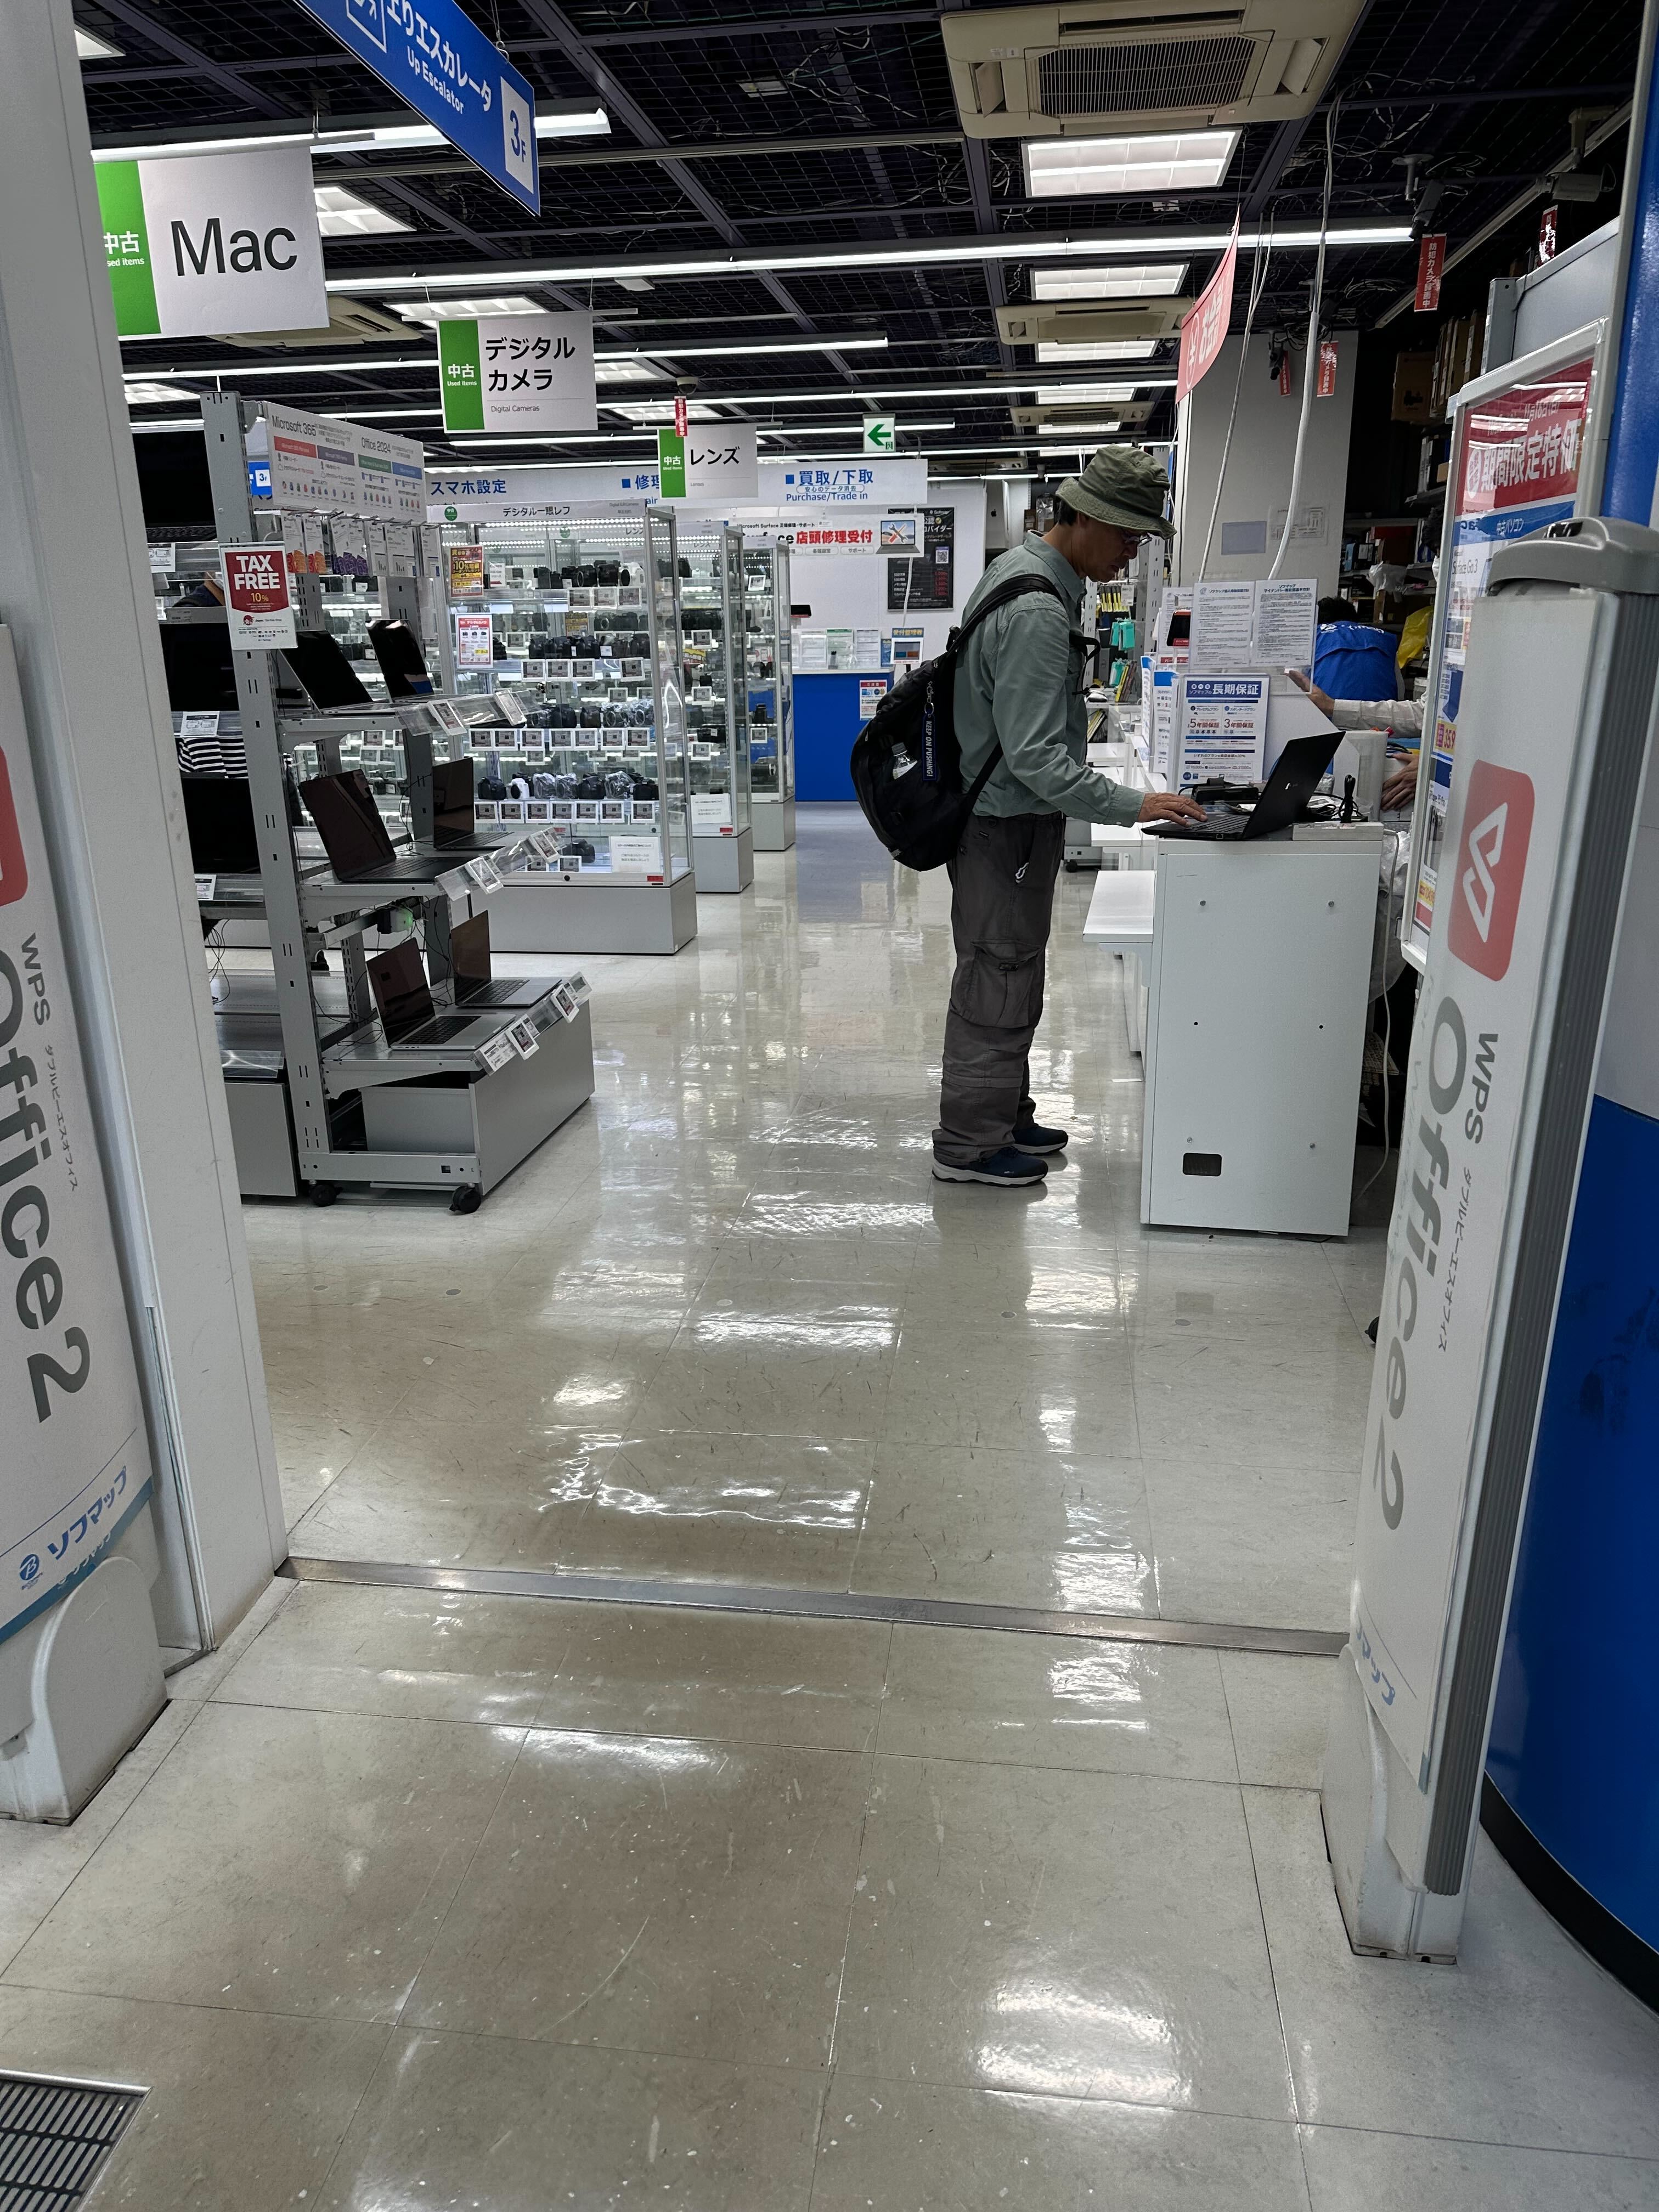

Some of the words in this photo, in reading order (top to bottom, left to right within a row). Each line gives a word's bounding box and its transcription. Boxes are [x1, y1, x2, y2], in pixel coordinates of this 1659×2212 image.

[407, 46, 421, 76] Up
[422, 64, 465, 115] Escalator
[510, 110, 527, 163] 3F
[103, 230, 140, 255] 中古
[170, 218, 298, 277] Mac
[106, 258, 121, 267] sed
[122, 258, 145, 266] items
[486, 336, 575, 361] デジタル
[448, 363, 475, 379] 中古
[488, 368, 552, 392] カメラ
[491, 405, 511, 414] Digital
[272, 415, 302, 435] Microsoft
[303, 421, 317, 437] 365
[361, 437, 376, 451] Office
[377, 440, 391, 454] 2024
[663, 455, 681, 466] 中古
[690, 445, 740, 465] レンズ
[1481, 419, 1582, 490] 期間限定特価
[799, 469, 874, 486] 買取/下取
[431, 479, 507, 495] スマホ設定
[786, 492, 857, 502] Purchase/Trade
[859, 492, 868, 500] in
[796, 529, 873, 544] 店頭修理受付
[236, 555, 274, 572] TAX
[234, 572, 280, 590] FREE
[250, 592, 269, 602] 10%
[1212, 684, 1259, 695] 長期保証
[1190, 718, 1220, 728] 5年間保証
[1224, 718, 1254, 728] 3年間保証
[926, 736, 933, 747] ON
[21, 932, 50, 1025] WPS
[1464, 1033, 1499, 1144] WPS
[47, 1465, 127, 1560] ソフマップ
